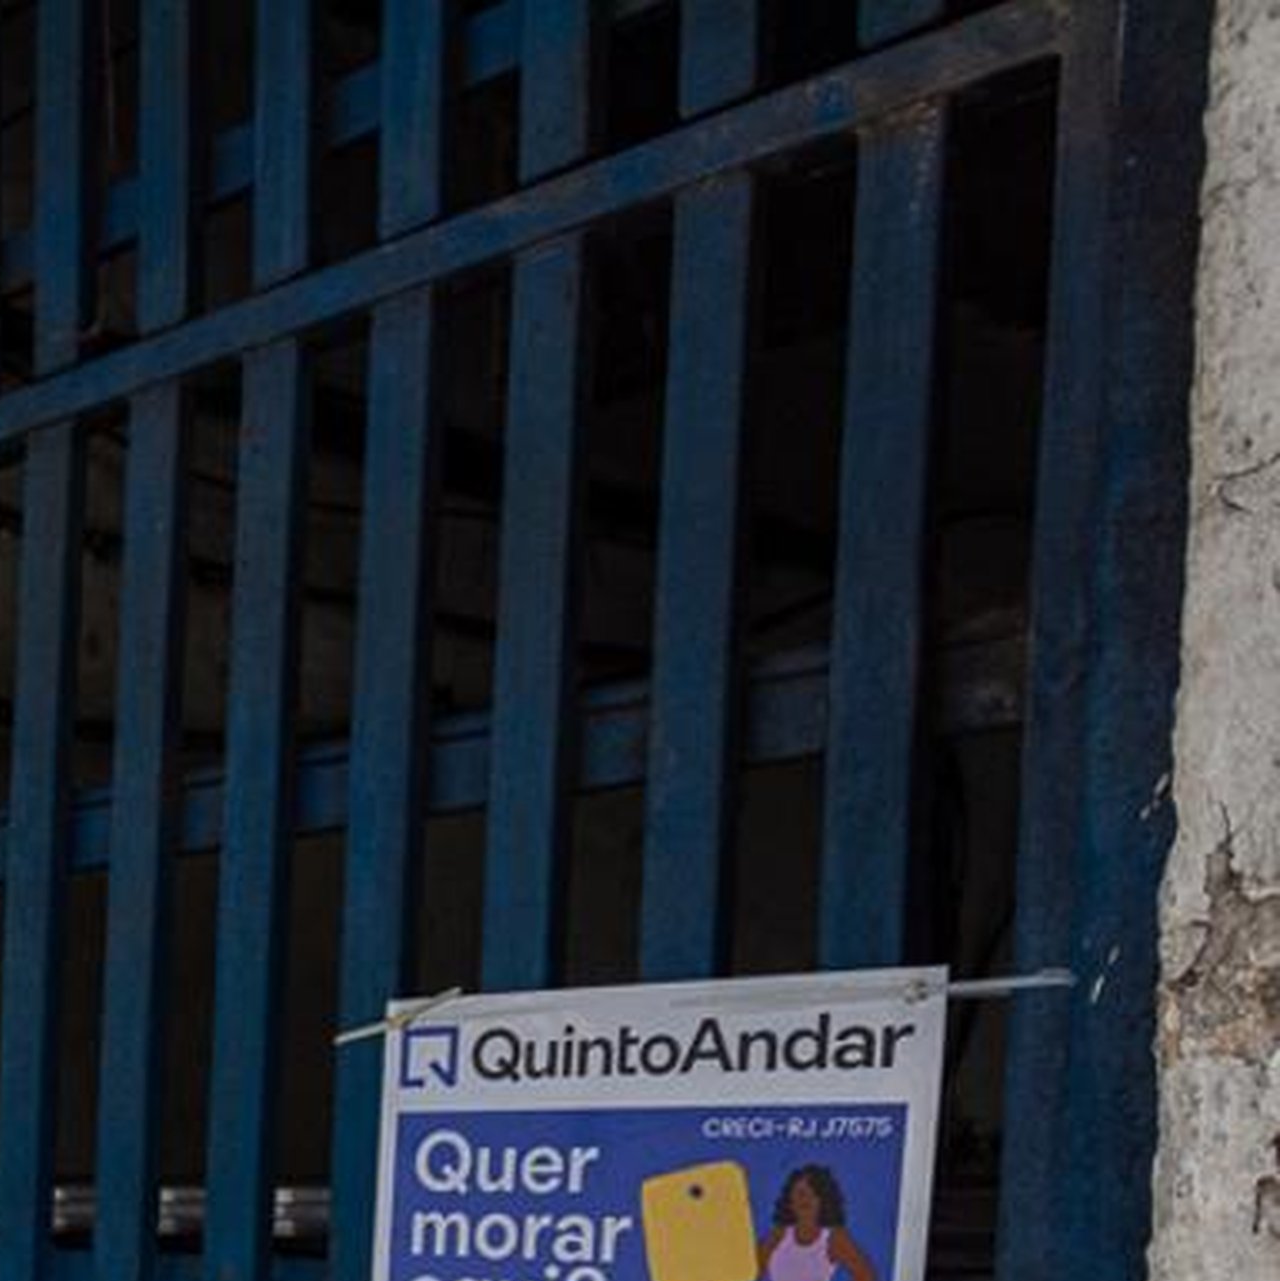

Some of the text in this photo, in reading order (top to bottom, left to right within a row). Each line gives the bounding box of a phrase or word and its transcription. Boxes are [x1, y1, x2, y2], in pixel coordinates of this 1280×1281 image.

[471, 1012, 915, 1081] QuintoAndar
[415, 1130, 600, 1194] Quer
[410, 1212, 633, 1262] morar
